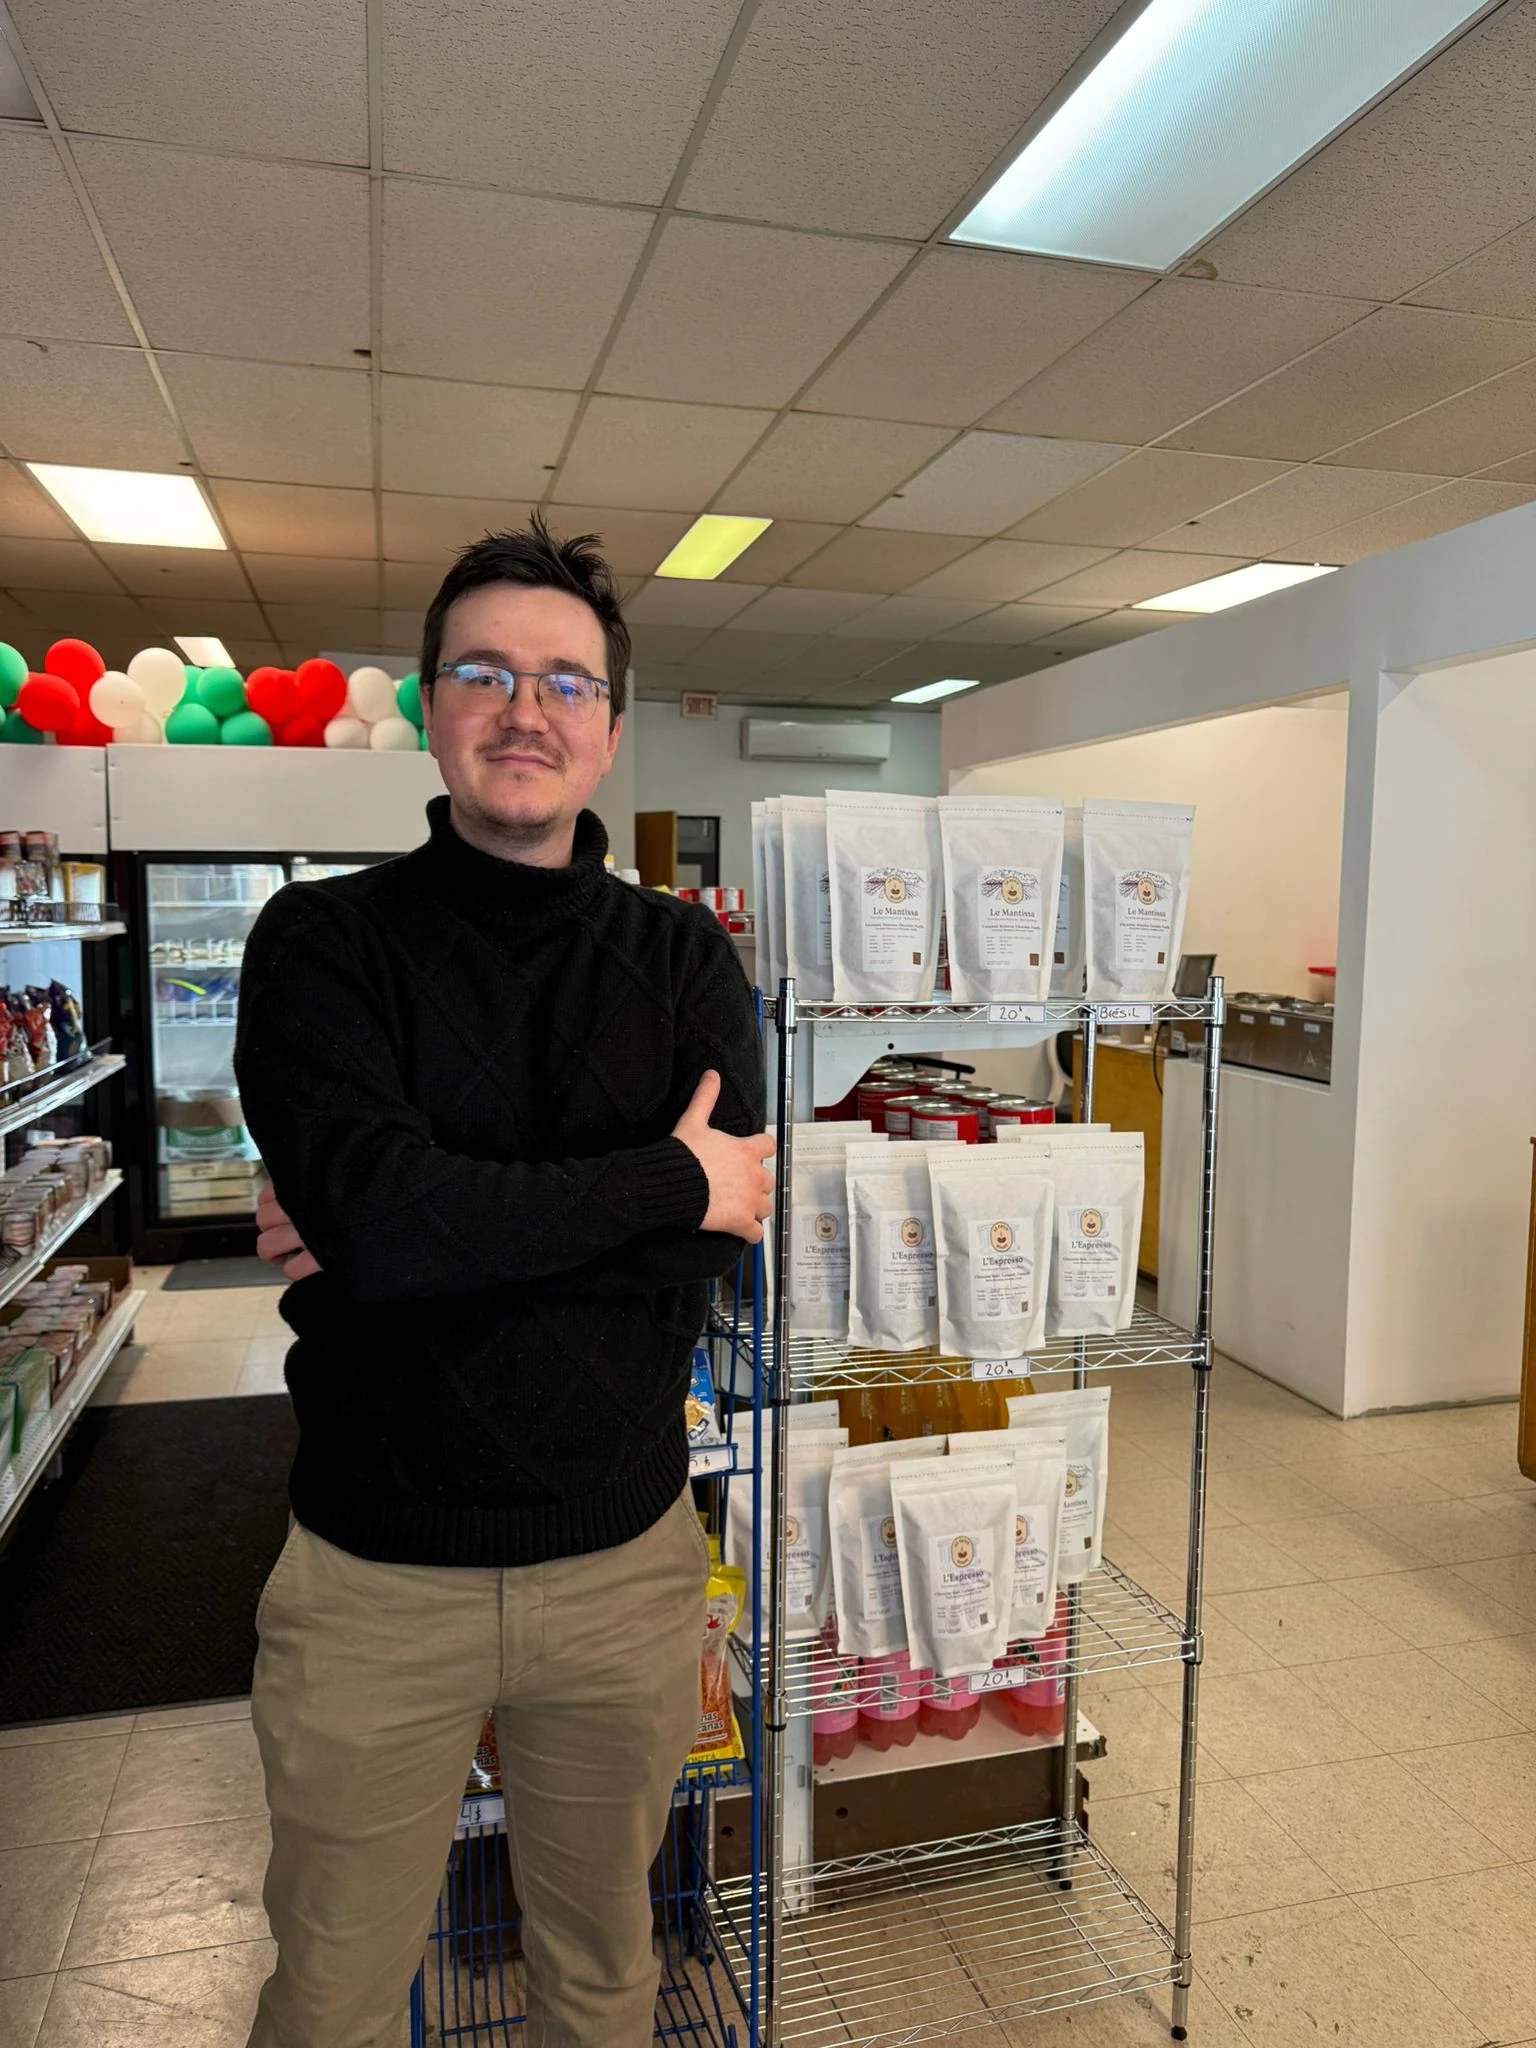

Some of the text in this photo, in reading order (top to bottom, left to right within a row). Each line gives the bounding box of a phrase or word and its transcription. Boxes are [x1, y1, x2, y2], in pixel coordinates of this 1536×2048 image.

[687, 696, 714, 716] SORTIE
[872, 906, 919, 917] Le Mantissa
[990, 908, 1035, 918] Le Mantissa
[1127, 907, 1166, 917] Le Mantissa
[1071, 1240, 1112, 1251] L'Espresso
[982, 1256, 1024, 1268] L'Espresso
[942, 1569, 985, 1584] L'Espresso
